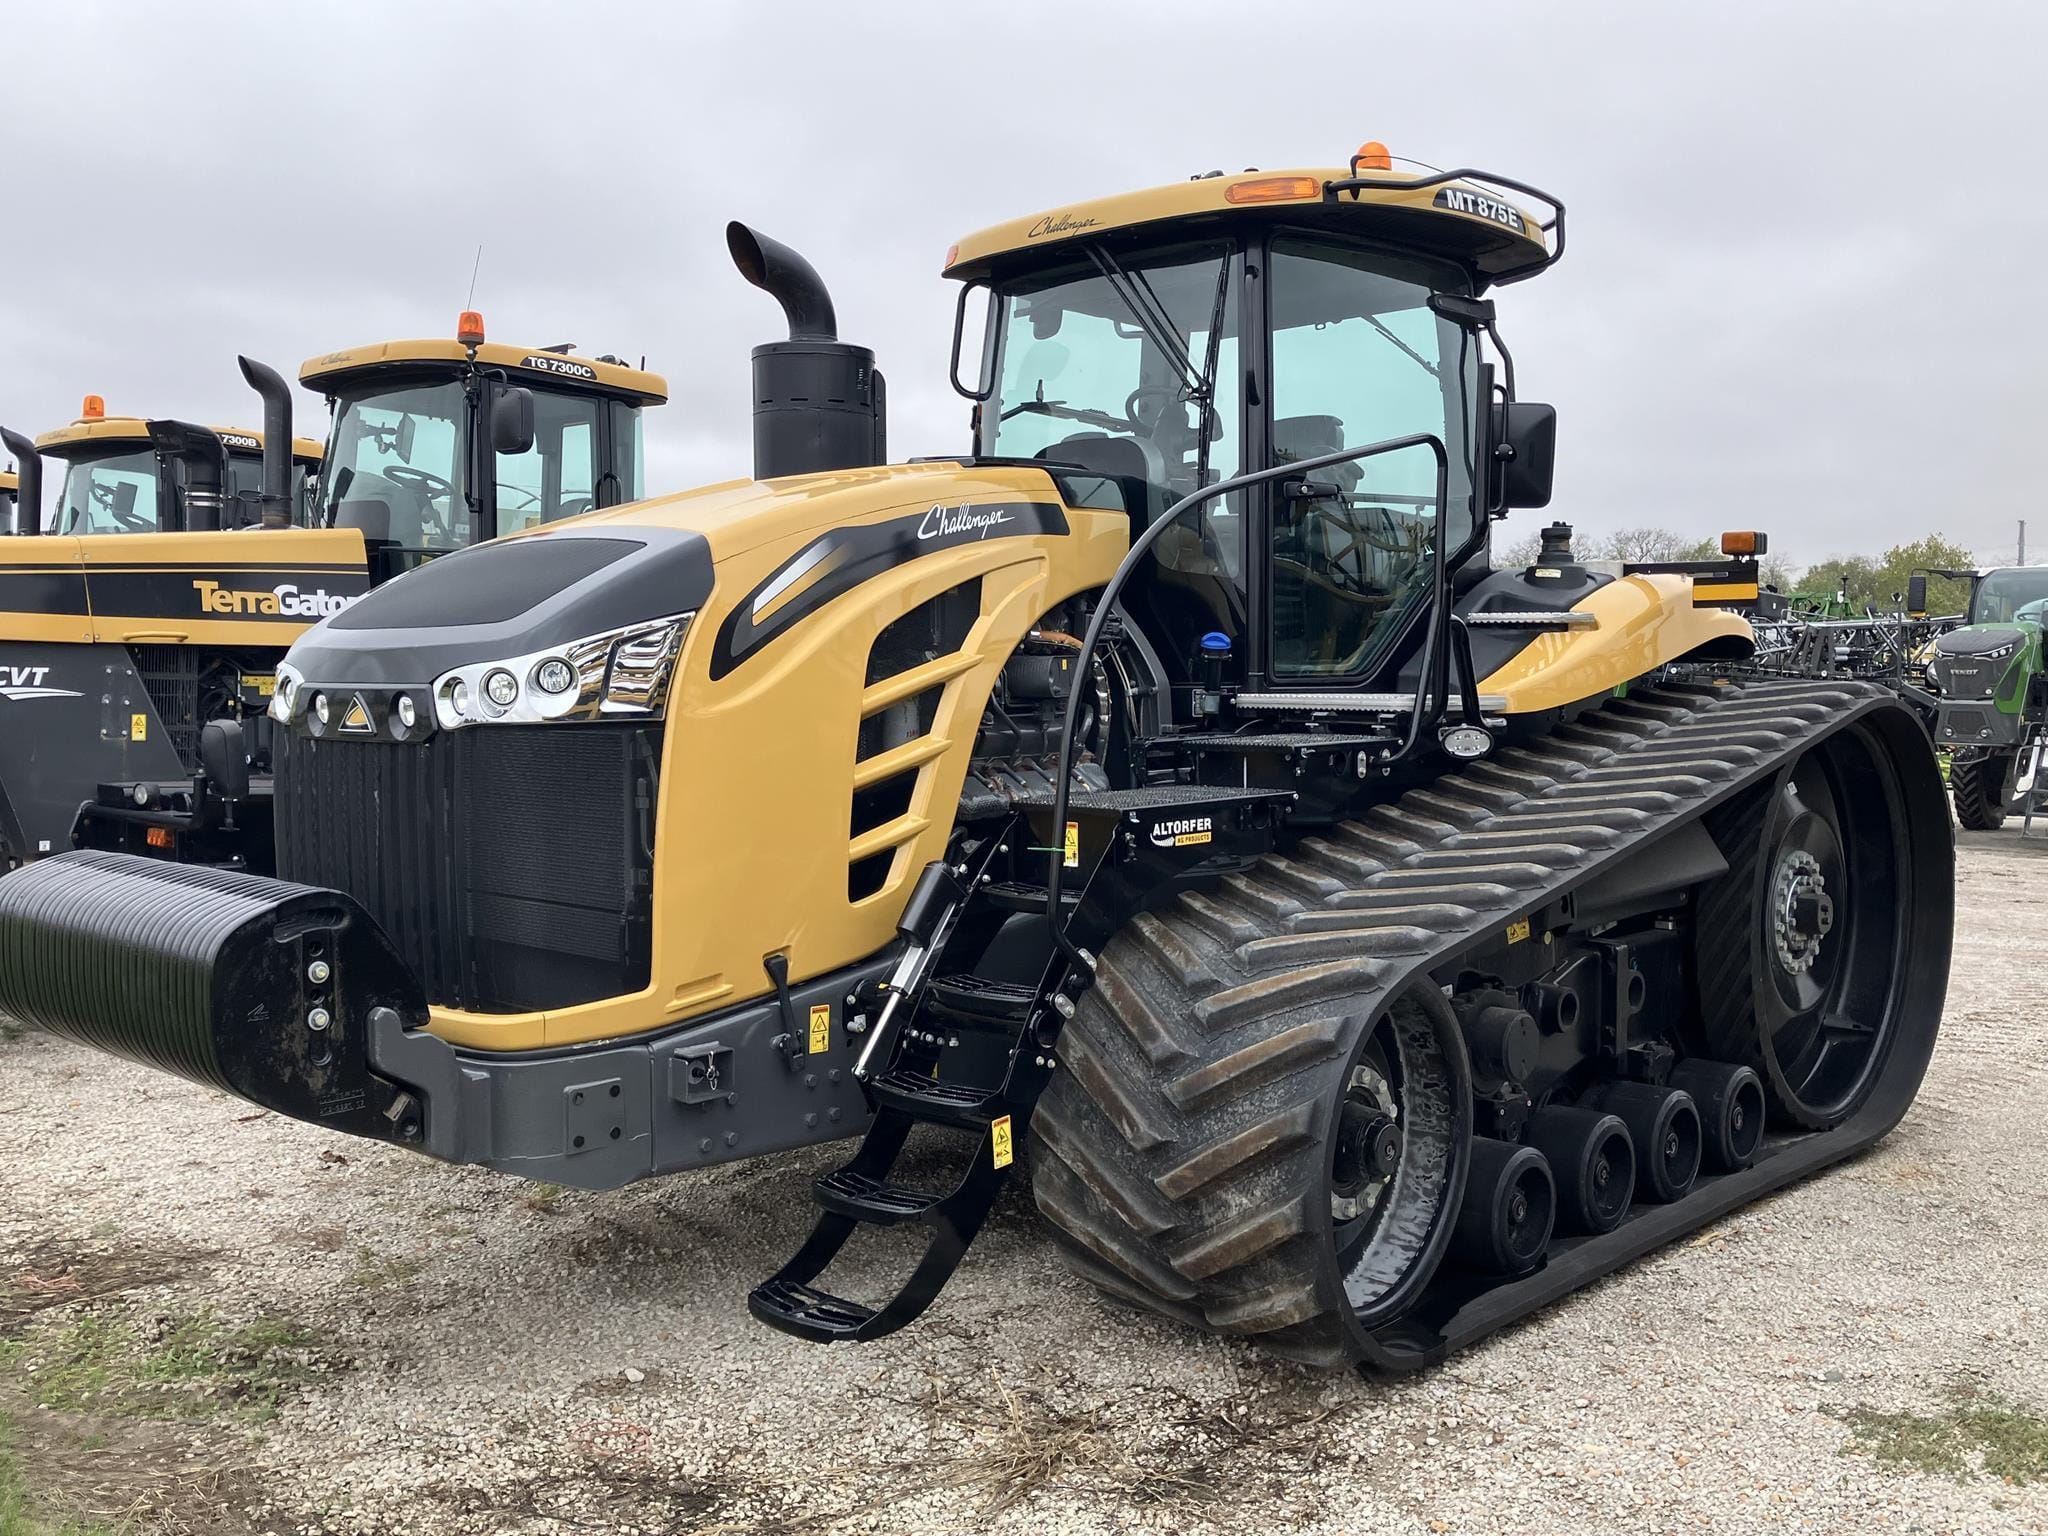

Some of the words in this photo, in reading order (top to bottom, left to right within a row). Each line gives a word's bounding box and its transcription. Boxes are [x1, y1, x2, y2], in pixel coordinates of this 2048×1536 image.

[1027, 213, 1105, 238] Challenger
[528, 356, 548, 369] TG
[549, 360, 592, 377] 7300C
[221, 434, 257, 447] 7300B
[917, 502, 1016, 540] Challenger
[193, 580, 356, 617] TerraGato
[1153, 817, 1212, 836] ALTORFER
